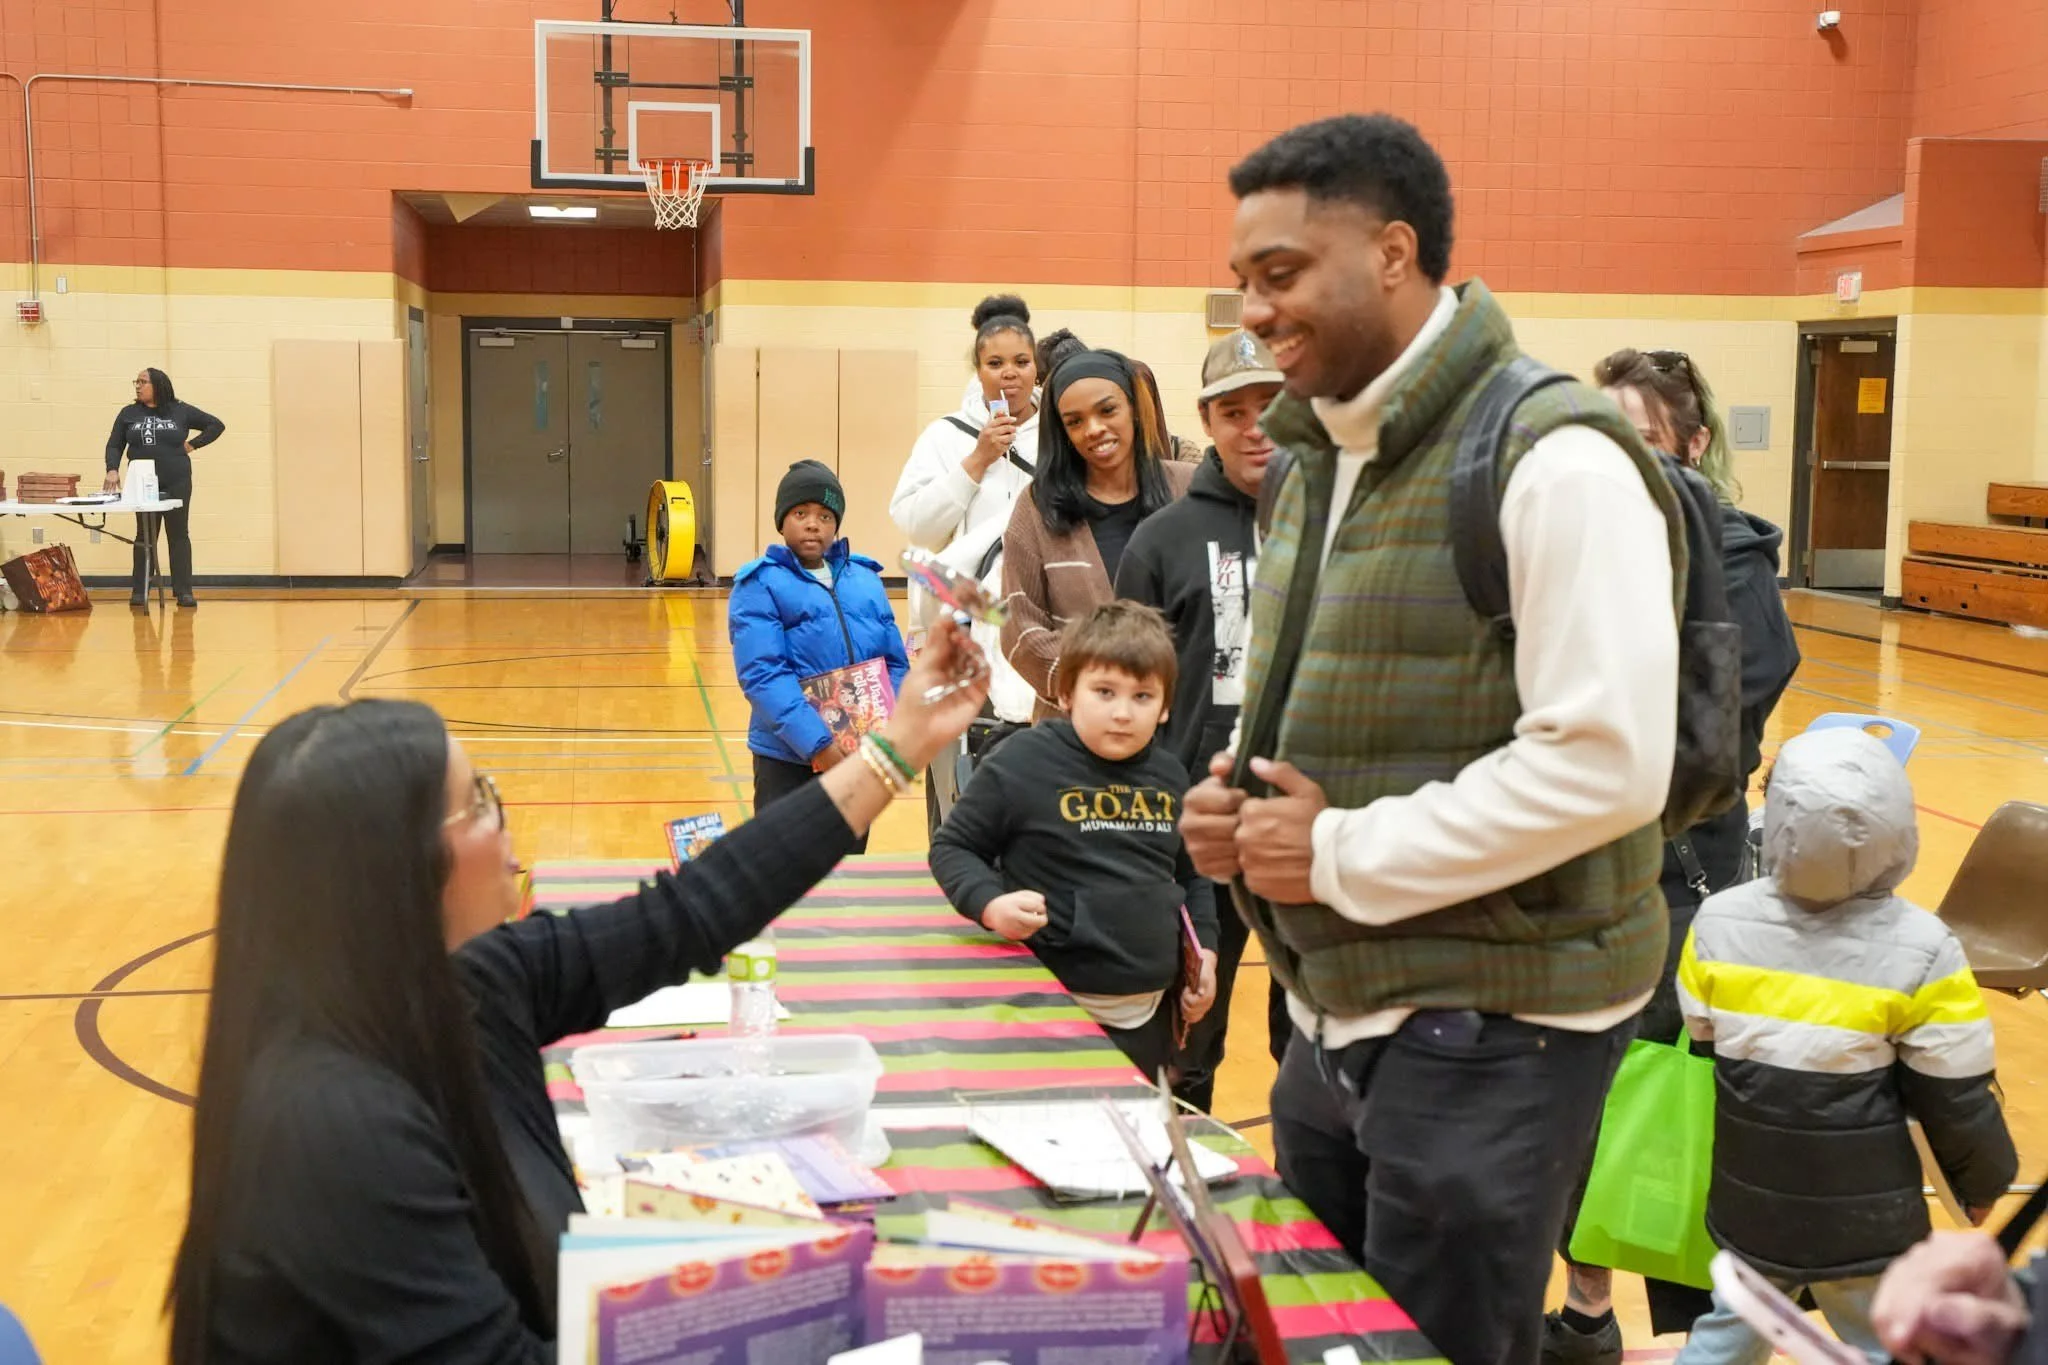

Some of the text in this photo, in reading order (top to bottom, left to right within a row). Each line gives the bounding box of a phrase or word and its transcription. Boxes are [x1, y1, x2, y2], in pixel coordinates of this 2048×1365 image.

[1109, 784, 1132, 794] THE
[1080, 820, 1172, 833] MUHAMMAD ALI
